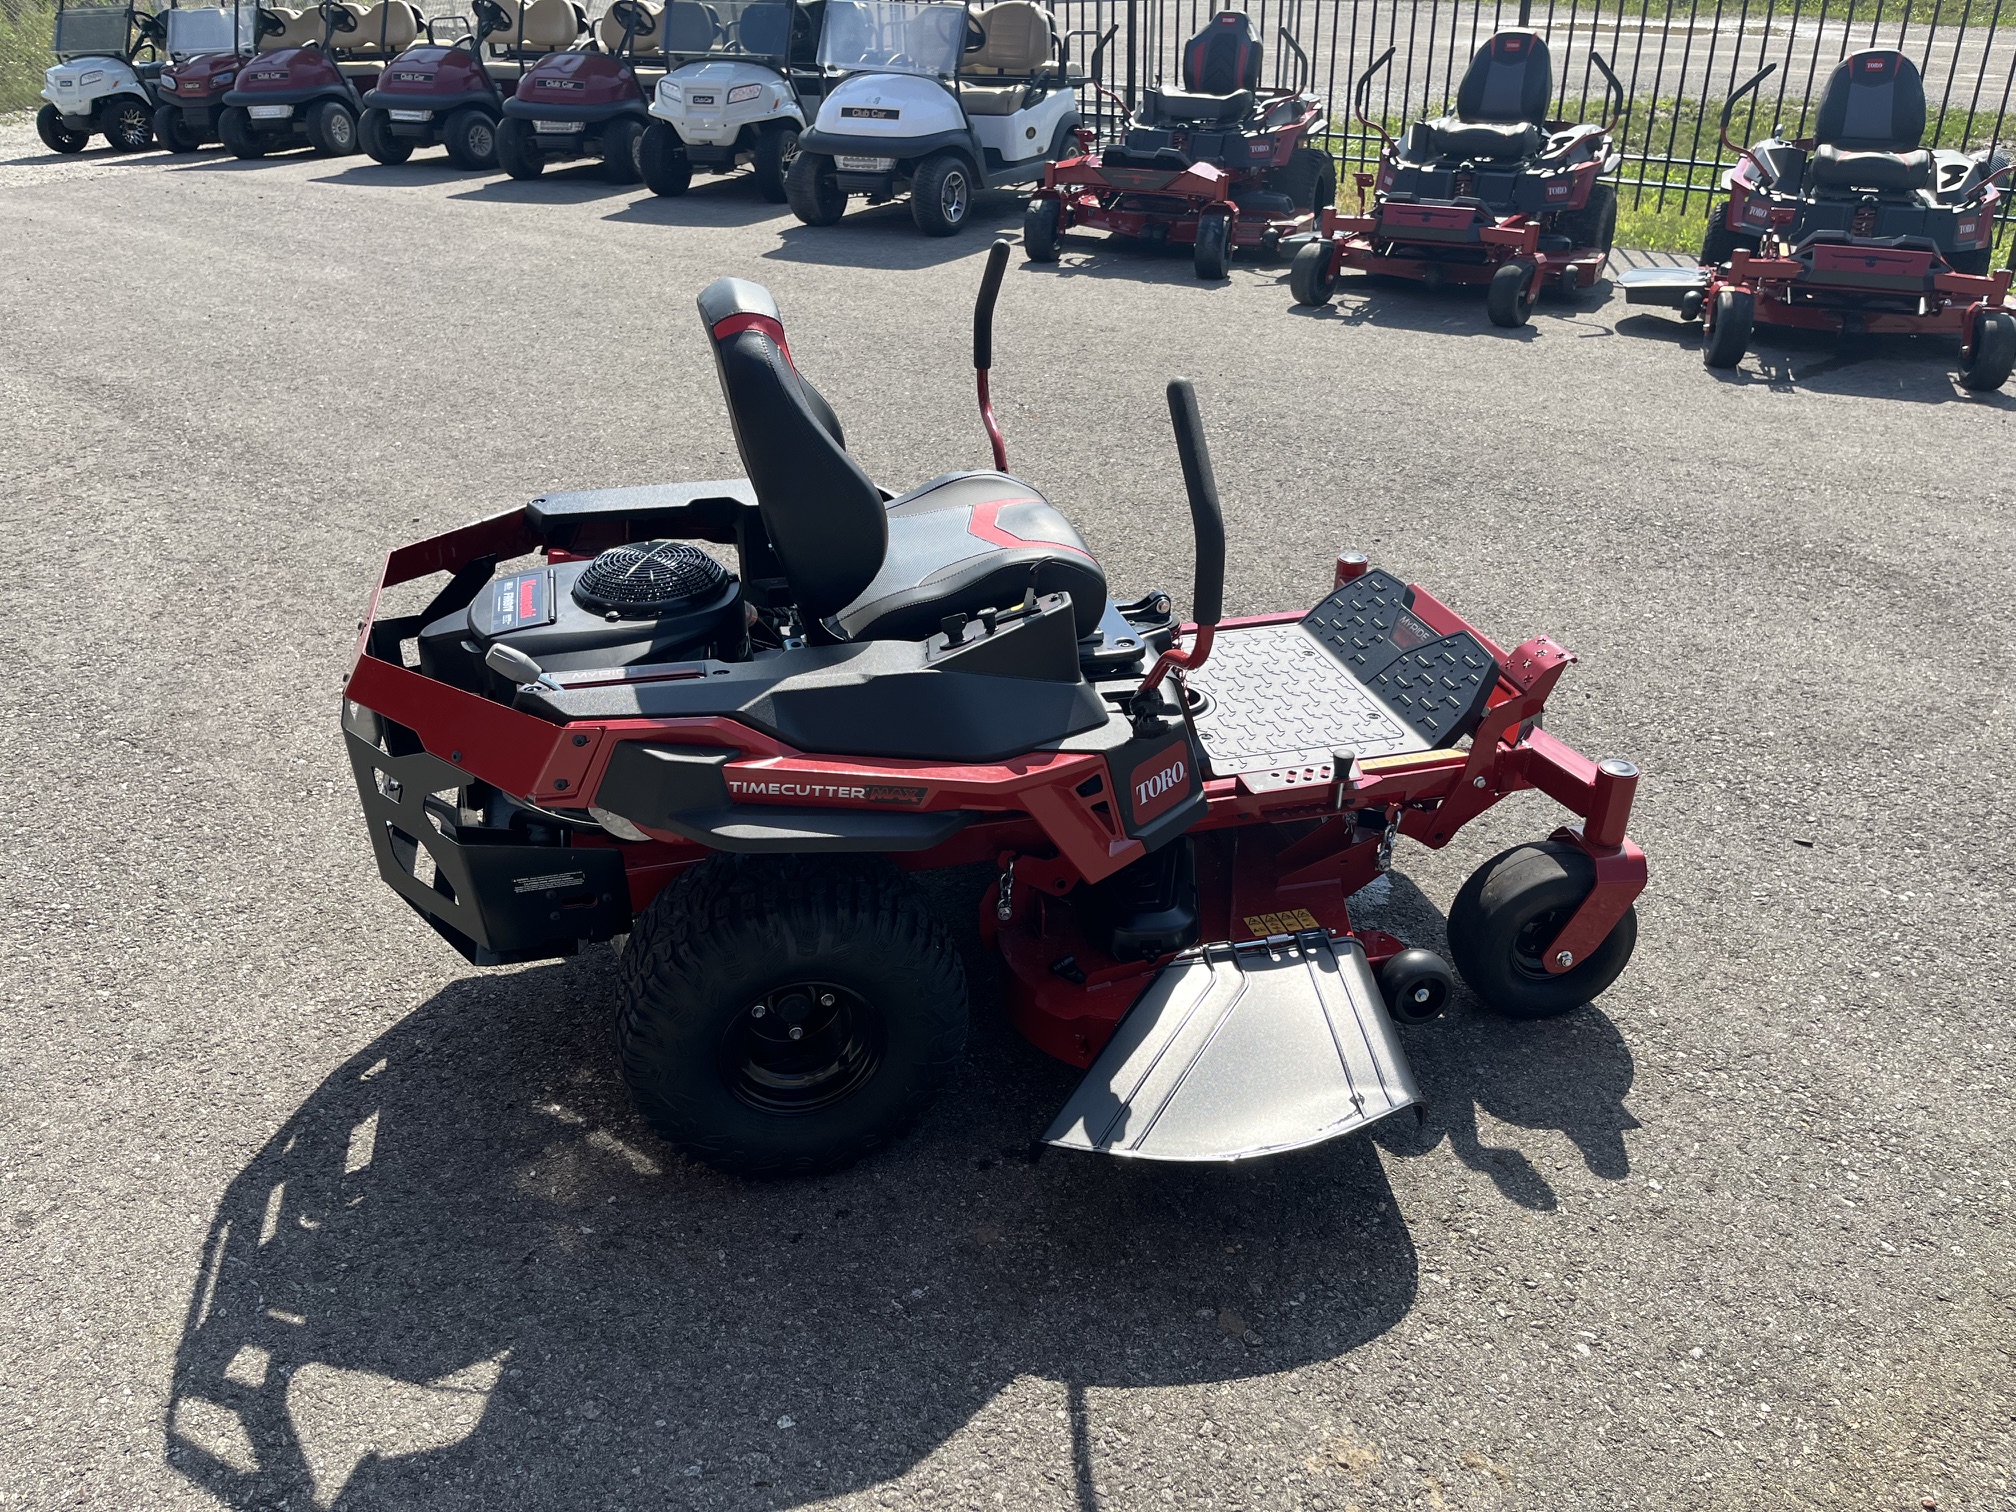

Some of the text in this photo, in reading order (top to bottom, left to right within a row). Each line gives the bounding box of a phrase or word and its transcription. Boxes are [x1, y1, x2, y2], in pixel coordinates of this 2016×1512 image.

[546, 80, 575, 89] Club Car
[852, 108, 887, 118] Club Car
[1250, 145, 1269, 153] TORO
[1547, 186, 1567, 195] TORO
[1749, 205, 1768, 218] TORO
[1959, 223, 1975, 234] TORO
[1135, 761, 1185, 806] TORO
[729, 781, 920, 802] TIMECUTTER MAX
